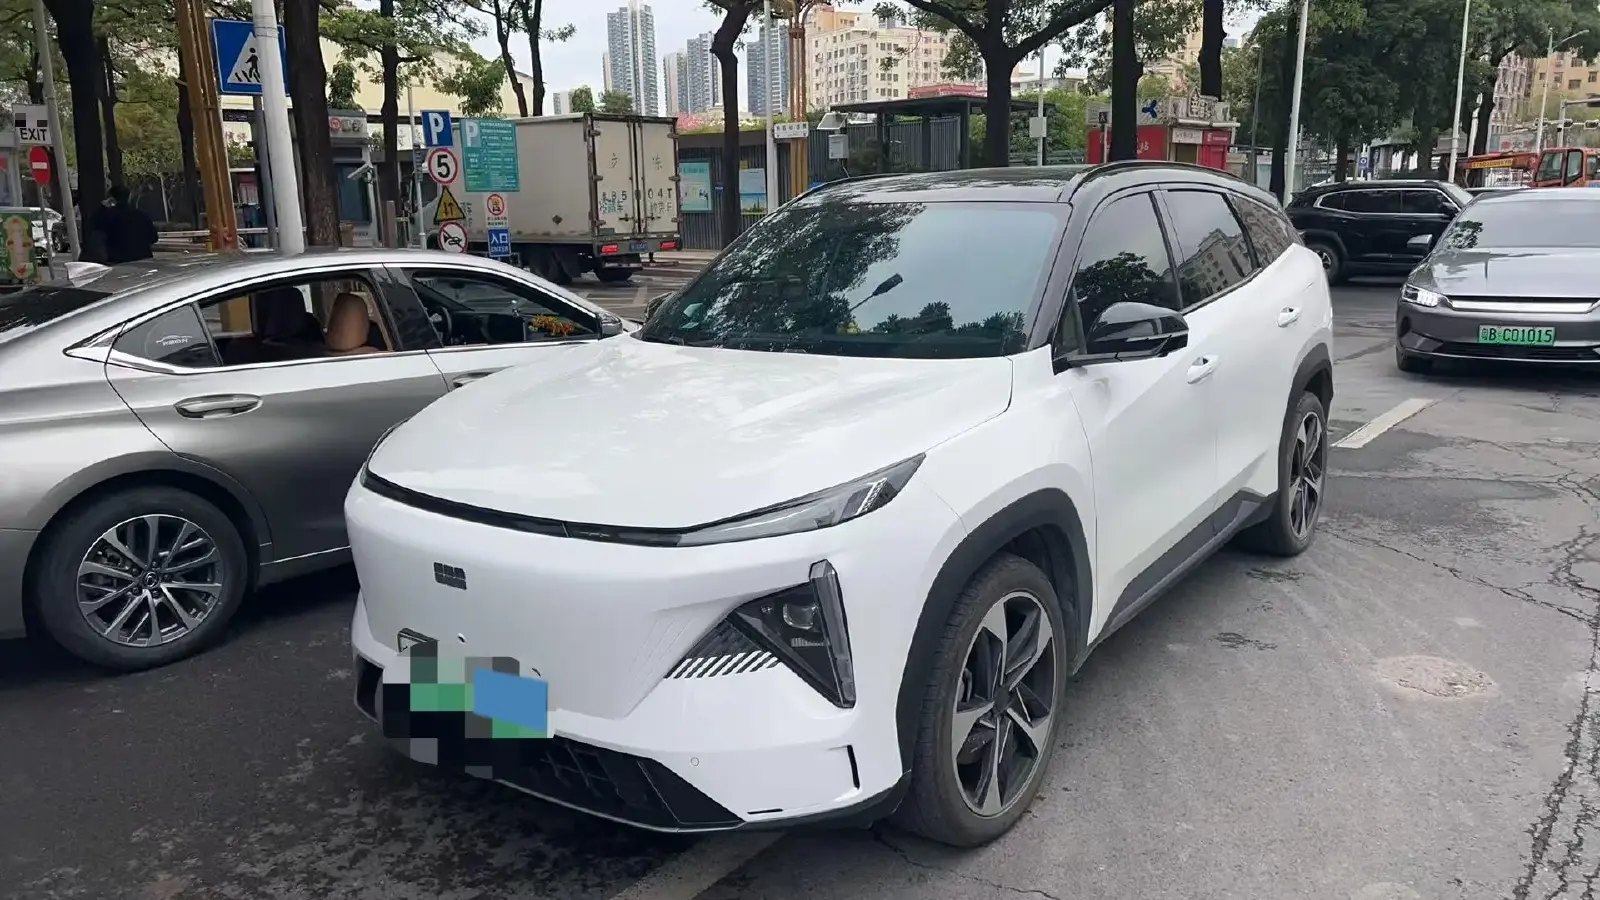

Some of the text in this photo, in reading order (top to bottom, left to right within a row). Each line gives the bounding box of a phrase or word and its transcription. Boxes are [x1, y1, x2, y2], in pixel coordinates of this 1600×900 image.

[19, 128, 47, 141] EXIT
[428, 112, 444, 145] P
[465, 119, 478, 147] P
[437, 154, 450, 178] 5
[491, 233, 508, 244] 入口
